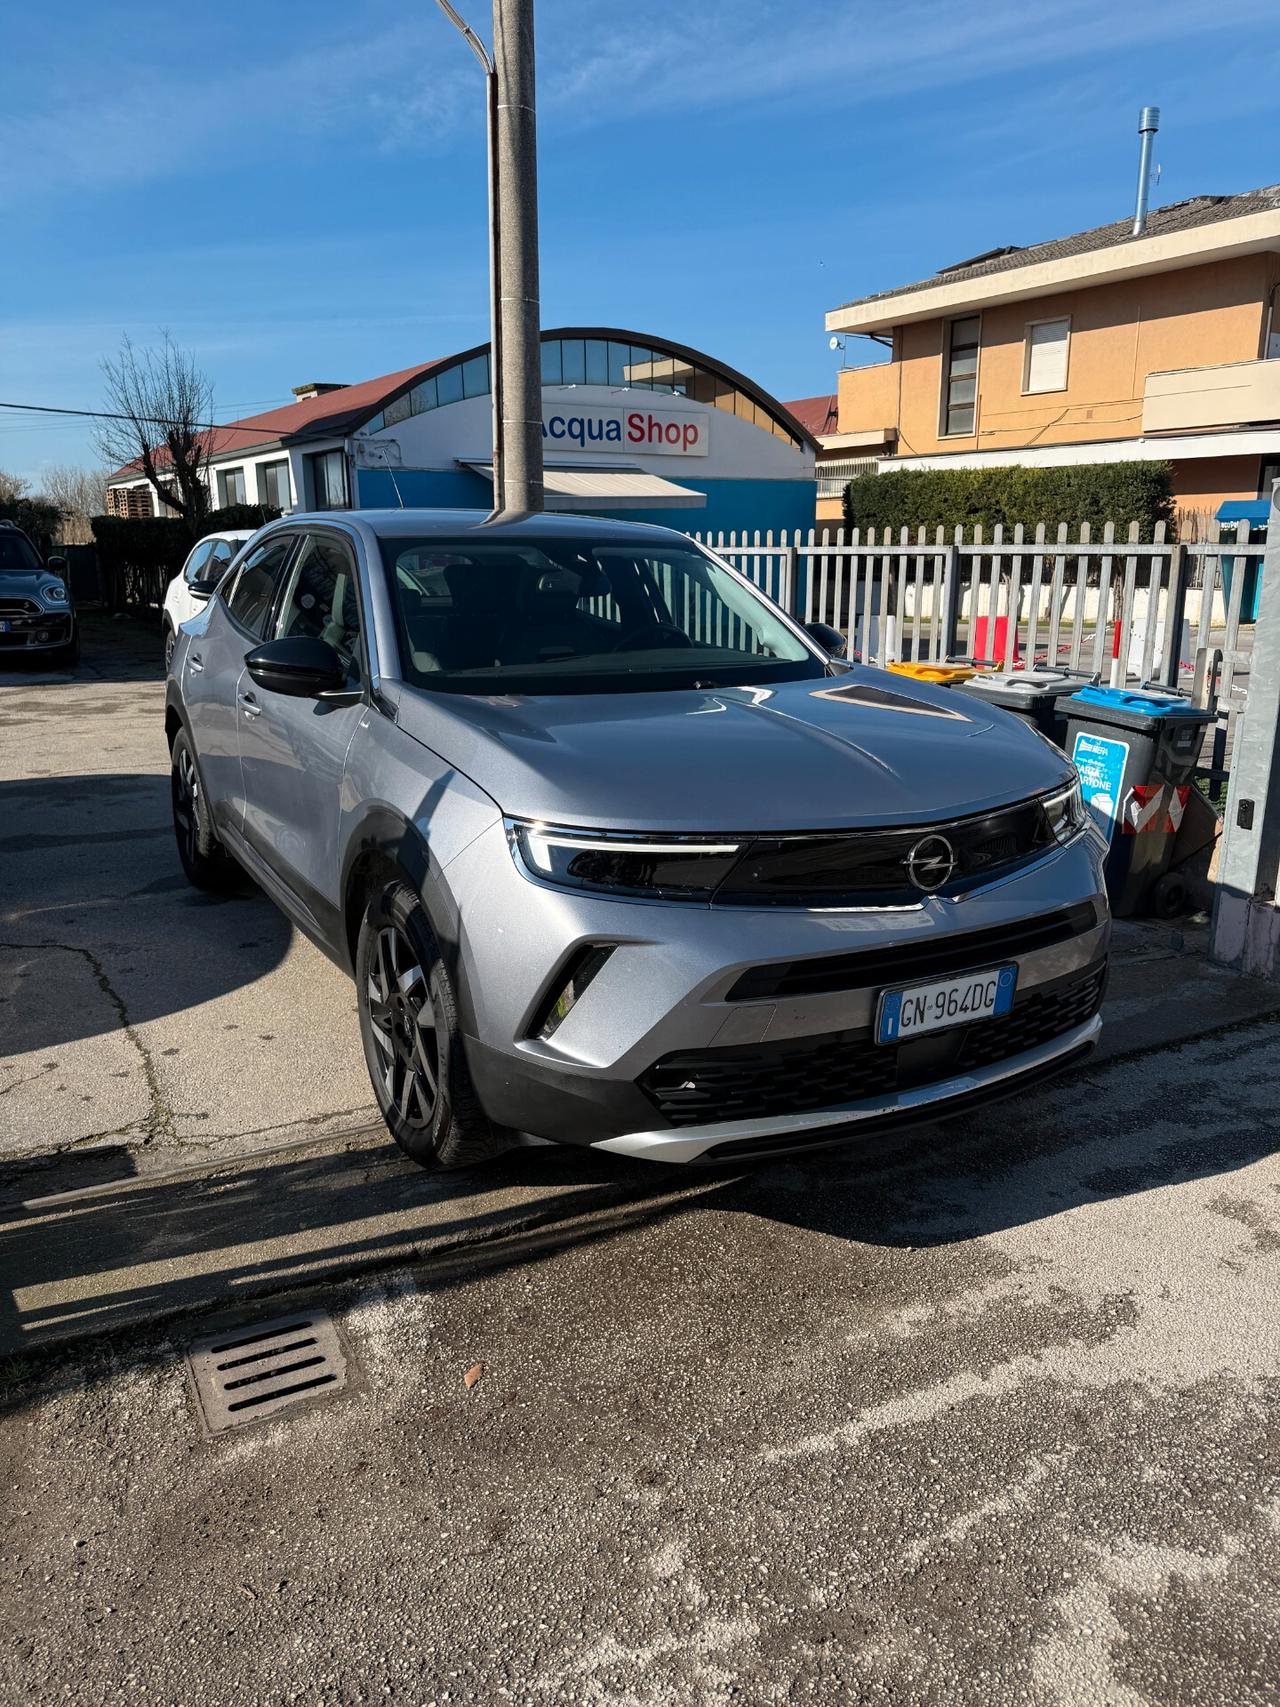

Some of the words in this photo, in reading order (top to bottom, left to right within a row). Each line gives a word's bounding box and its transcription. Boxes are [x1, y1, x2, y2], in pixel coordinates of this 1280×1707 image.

[541, 416, 622, 448] cqua
[627, 413, 699, 452] Shop
[1080, 774, 1113, 791] ARTONE
